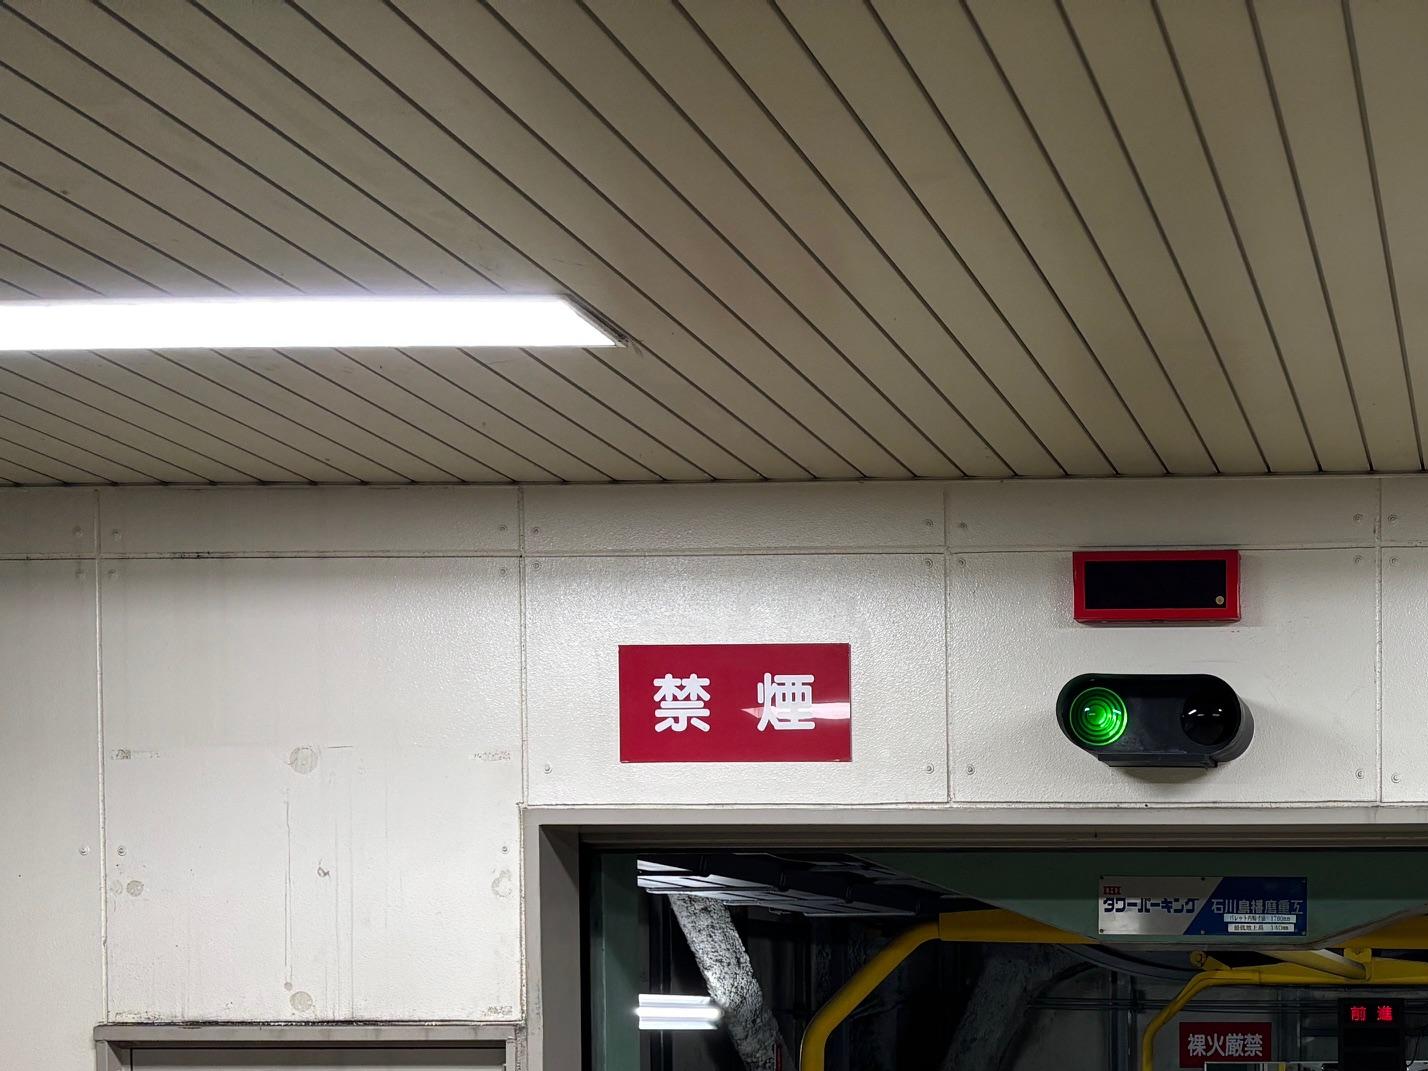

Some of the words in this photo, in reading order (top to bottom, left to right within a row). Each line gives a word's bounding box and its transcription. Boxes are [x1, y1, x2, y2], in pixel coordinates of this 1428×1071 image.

[653, 672, 816, 732] 禁煙
[1102, 897, 1200, 914] タワーパーキング
[1350, 1005, 1393, 1021] 前進
[1187, 1033, 1263, 1057] 裸火厳禁
